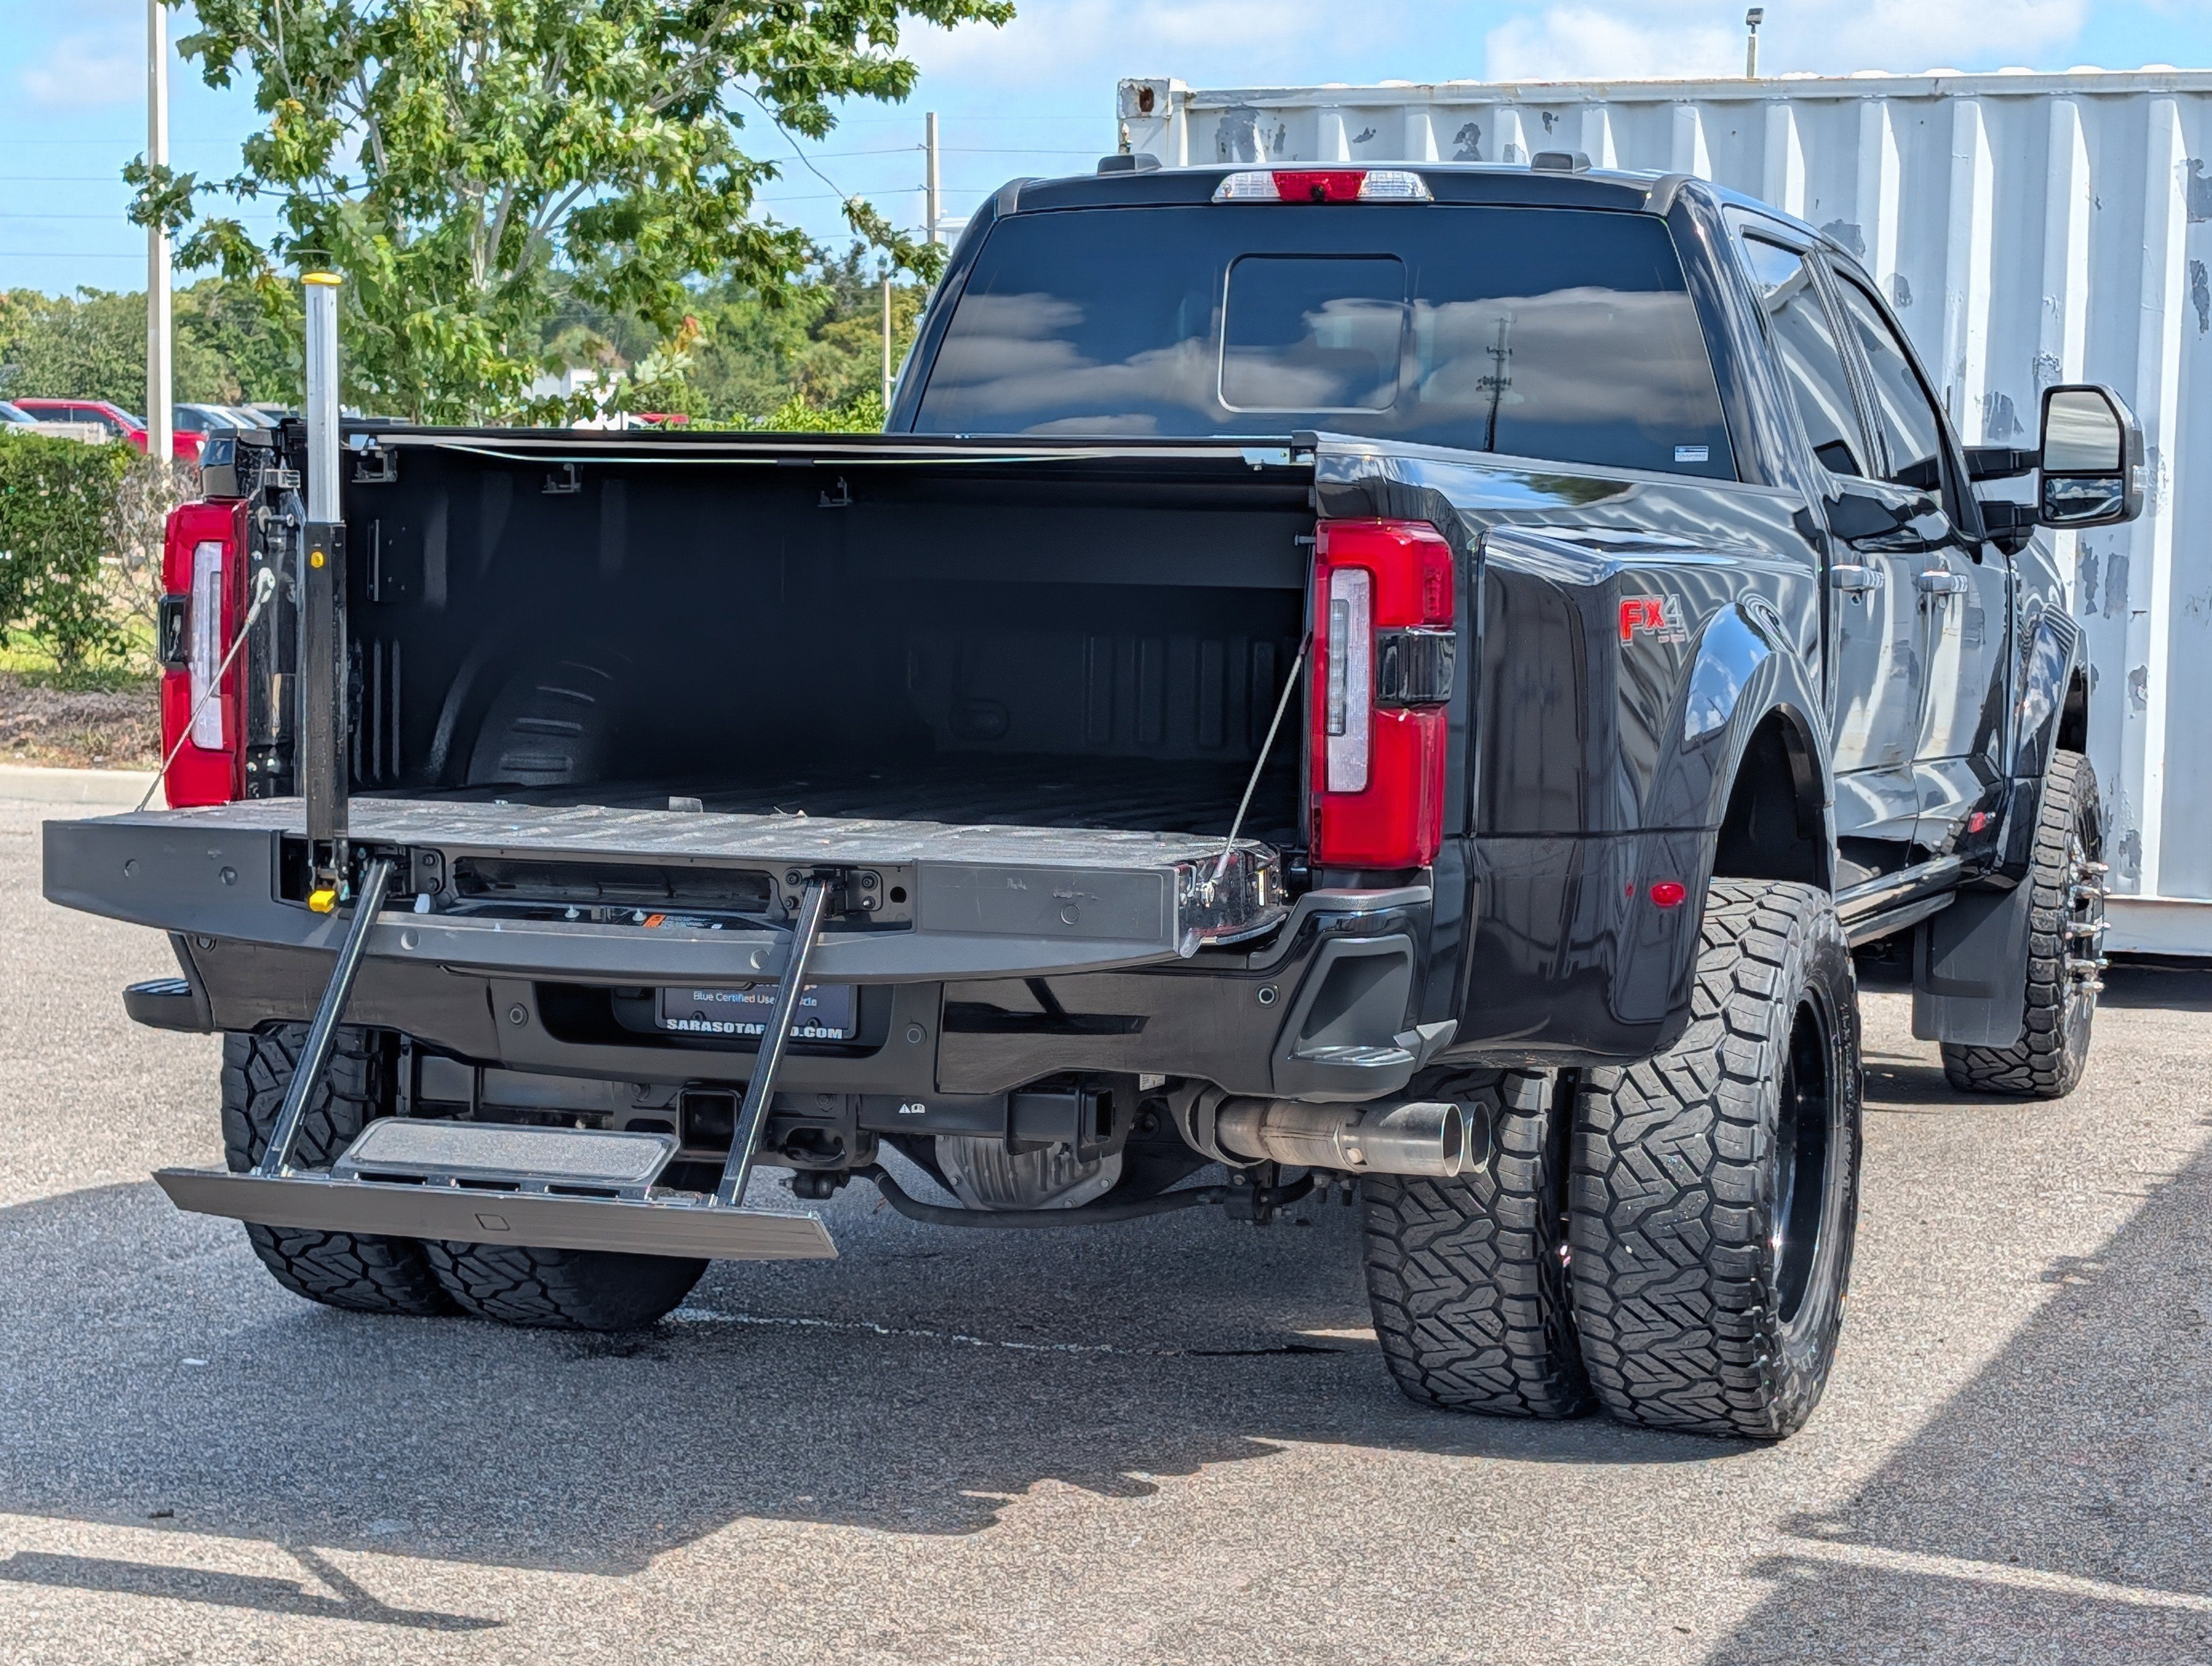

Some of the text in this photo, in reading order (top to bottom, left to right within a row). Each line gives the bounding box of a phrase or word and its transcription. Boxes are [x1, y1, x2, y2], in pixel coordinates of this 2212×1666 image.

[1619, 593, 1685, 645] FX4
[693, 990, 714, 1001] Blue
[716, 992, 756, 1003] Certified
[757, 994, 776, 1004] Use
[666, 1018, 843, 1040] SARASOTAFD.COM
